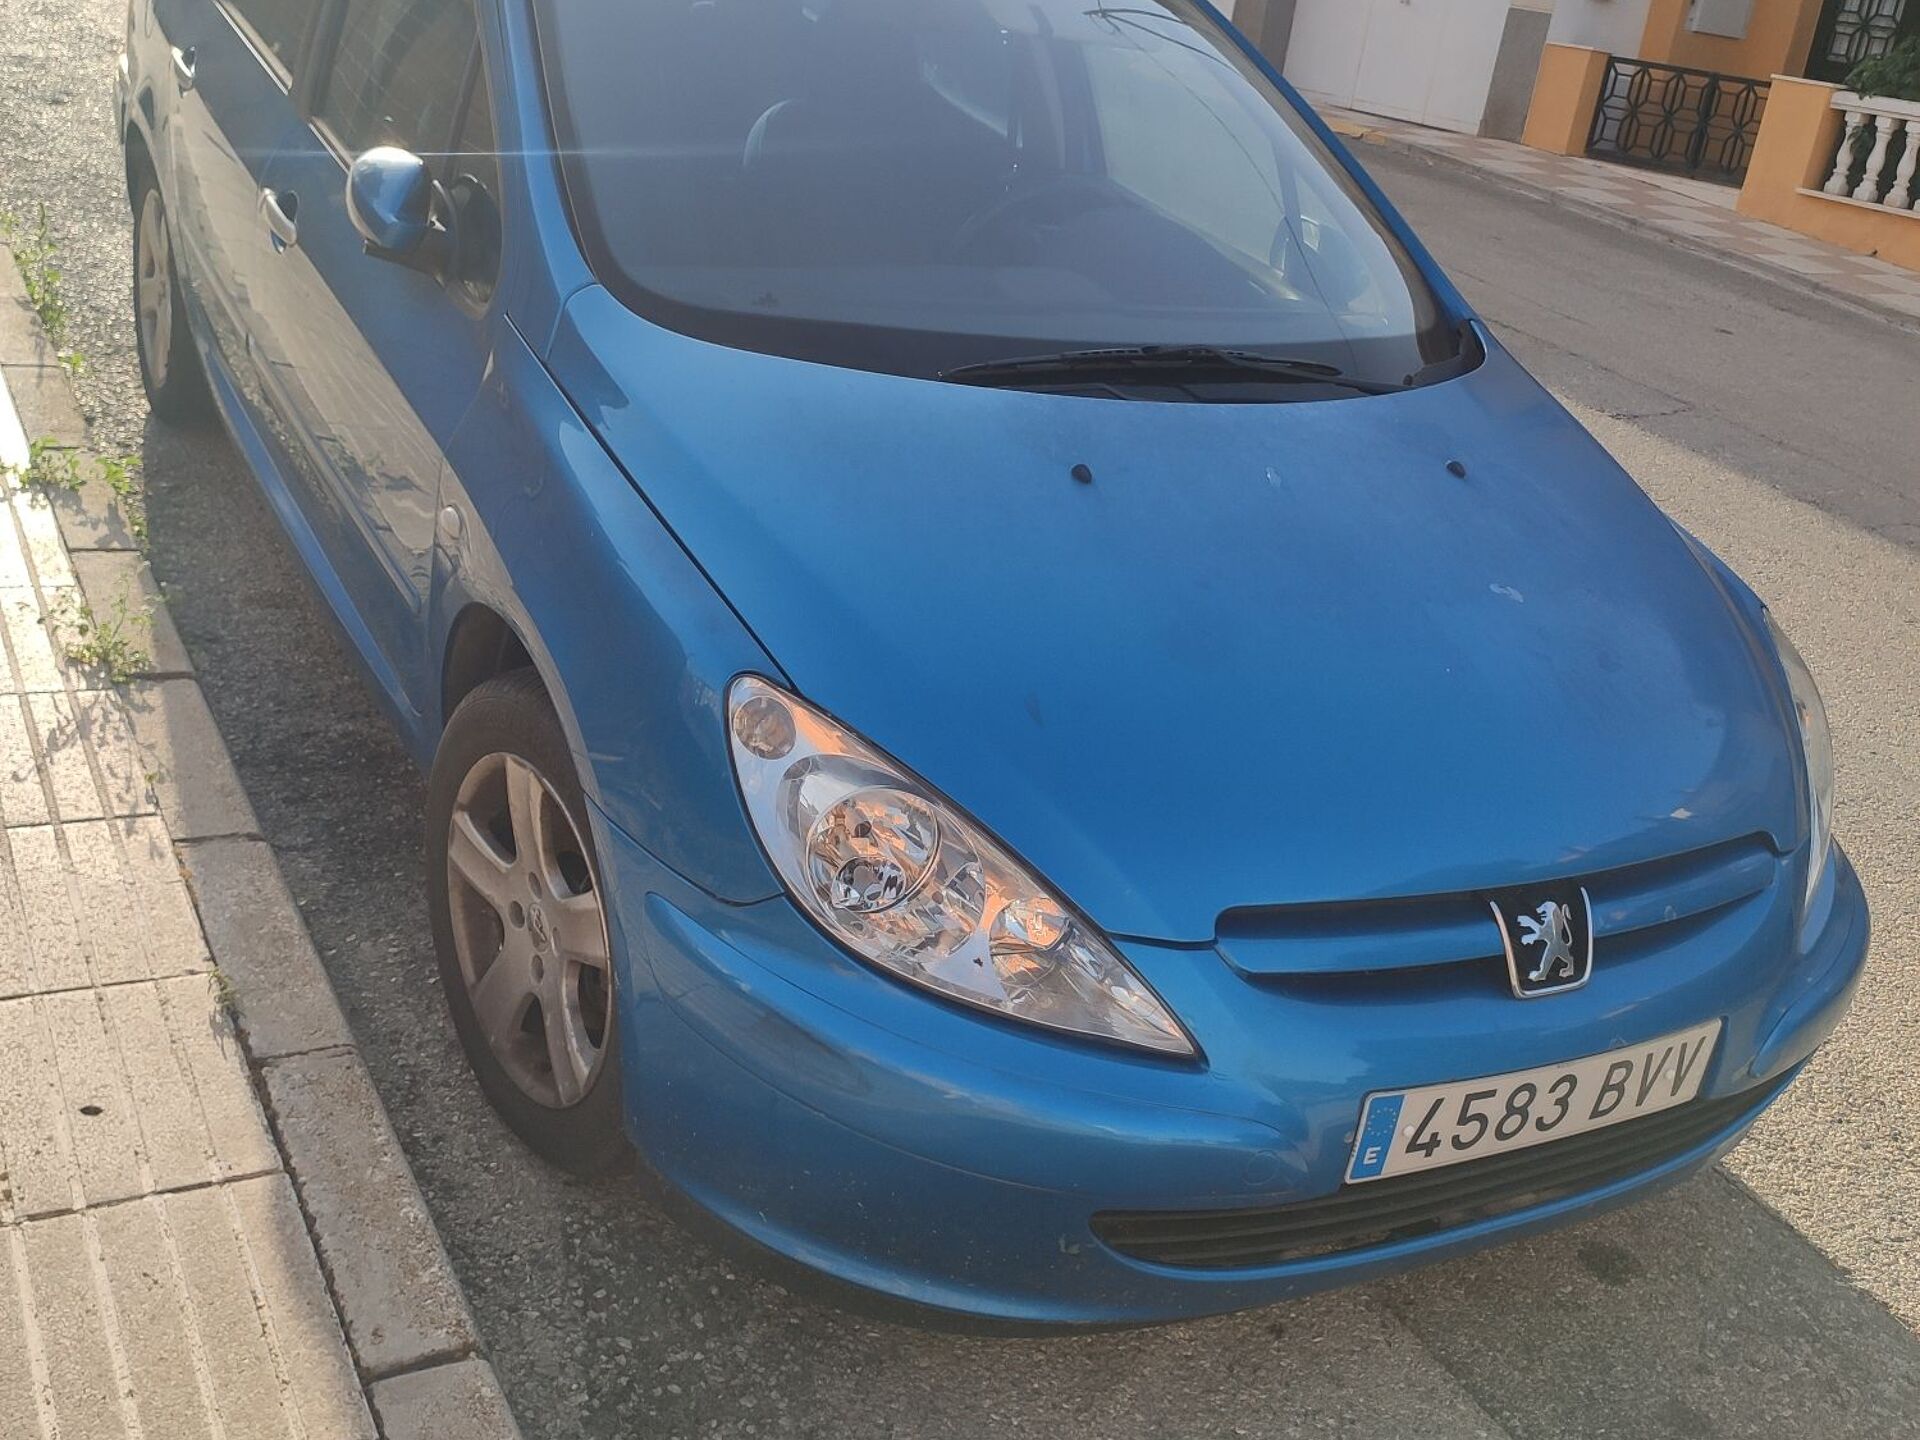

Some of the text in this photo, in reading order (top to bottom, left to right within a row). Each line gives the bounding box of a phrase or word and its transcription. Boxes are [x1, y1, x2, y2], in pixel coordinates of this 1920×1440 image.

[1405, 1036, 1706, 1157] 4583 BVV
[1363, 1146, 1381, 1165] E
